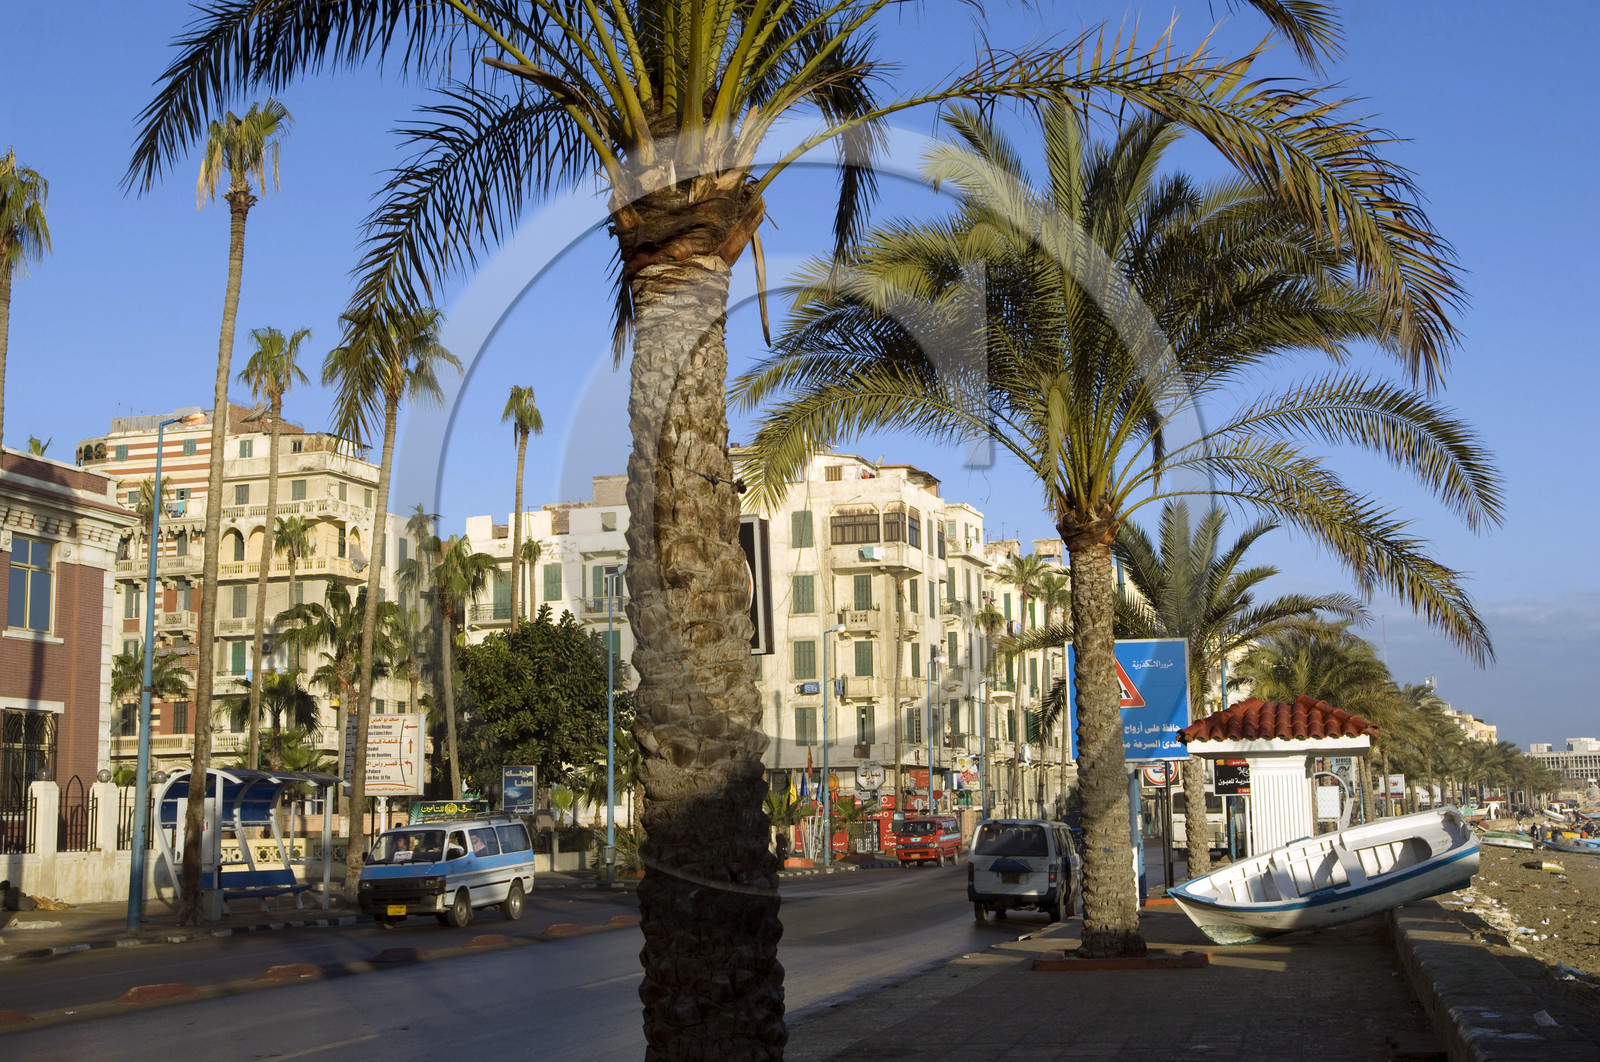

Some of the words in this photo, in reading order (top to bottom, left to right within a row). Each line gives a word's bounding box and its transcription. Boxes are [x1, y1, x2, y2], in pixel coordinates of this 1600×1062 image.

[1124, 721, 1143, 734] أرواح
[1144, 723, 1160, 734] على
[1133, 739, 1161, 750] السرعة
